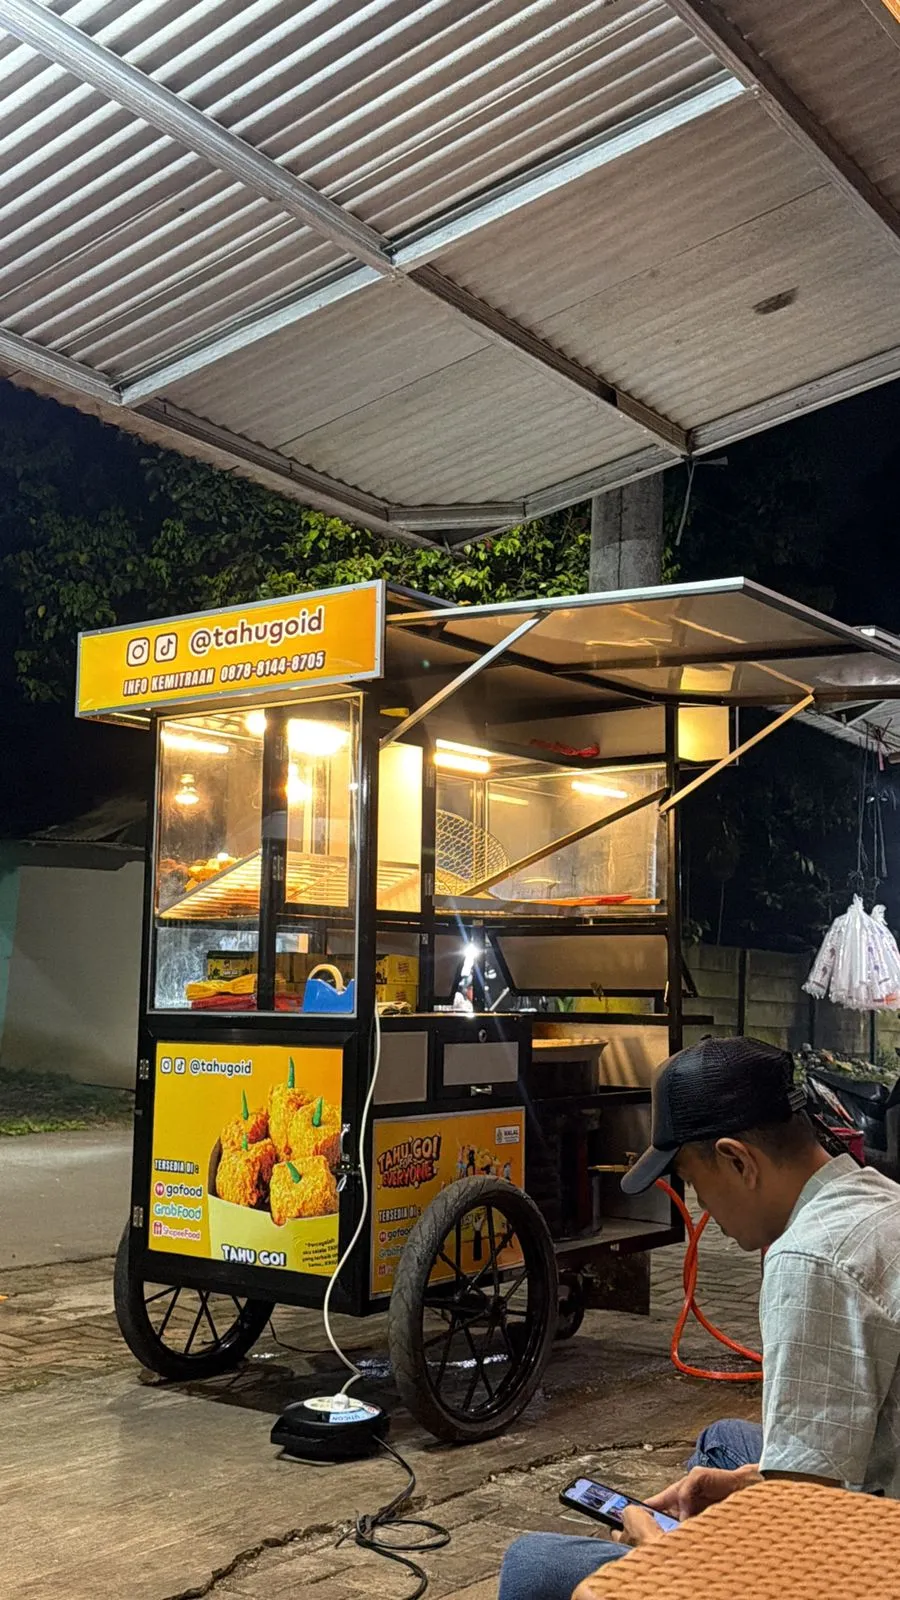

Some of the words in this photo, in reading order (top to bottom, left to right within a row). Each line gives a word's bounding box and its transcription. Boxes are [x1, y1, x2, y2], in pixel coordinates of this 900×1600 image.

[190, 608, 324, 654] @tahugoid
[124, 677, 148, 697] INFO
[150, 667, 214, 693] KEMITRAAN
[219, 651, 326, 683] 0878-8144-8705
[189, 1059, 252, 1075] @tahugoid
[377, 1142, 409, 1174] TAHU
[413, 1135, 441, 1160] GO!
[154, 1159, 185, 1174] TERSEDIA
[166, 1183, 203, 1197] gofood
[154, 1203, 202, 1220] GrabFood
[162, 1226, 201, 1241] ShopeeFood
[221, 1243, 257, 1265] TAHU
[258, 1250, 287, 1267] GO!
